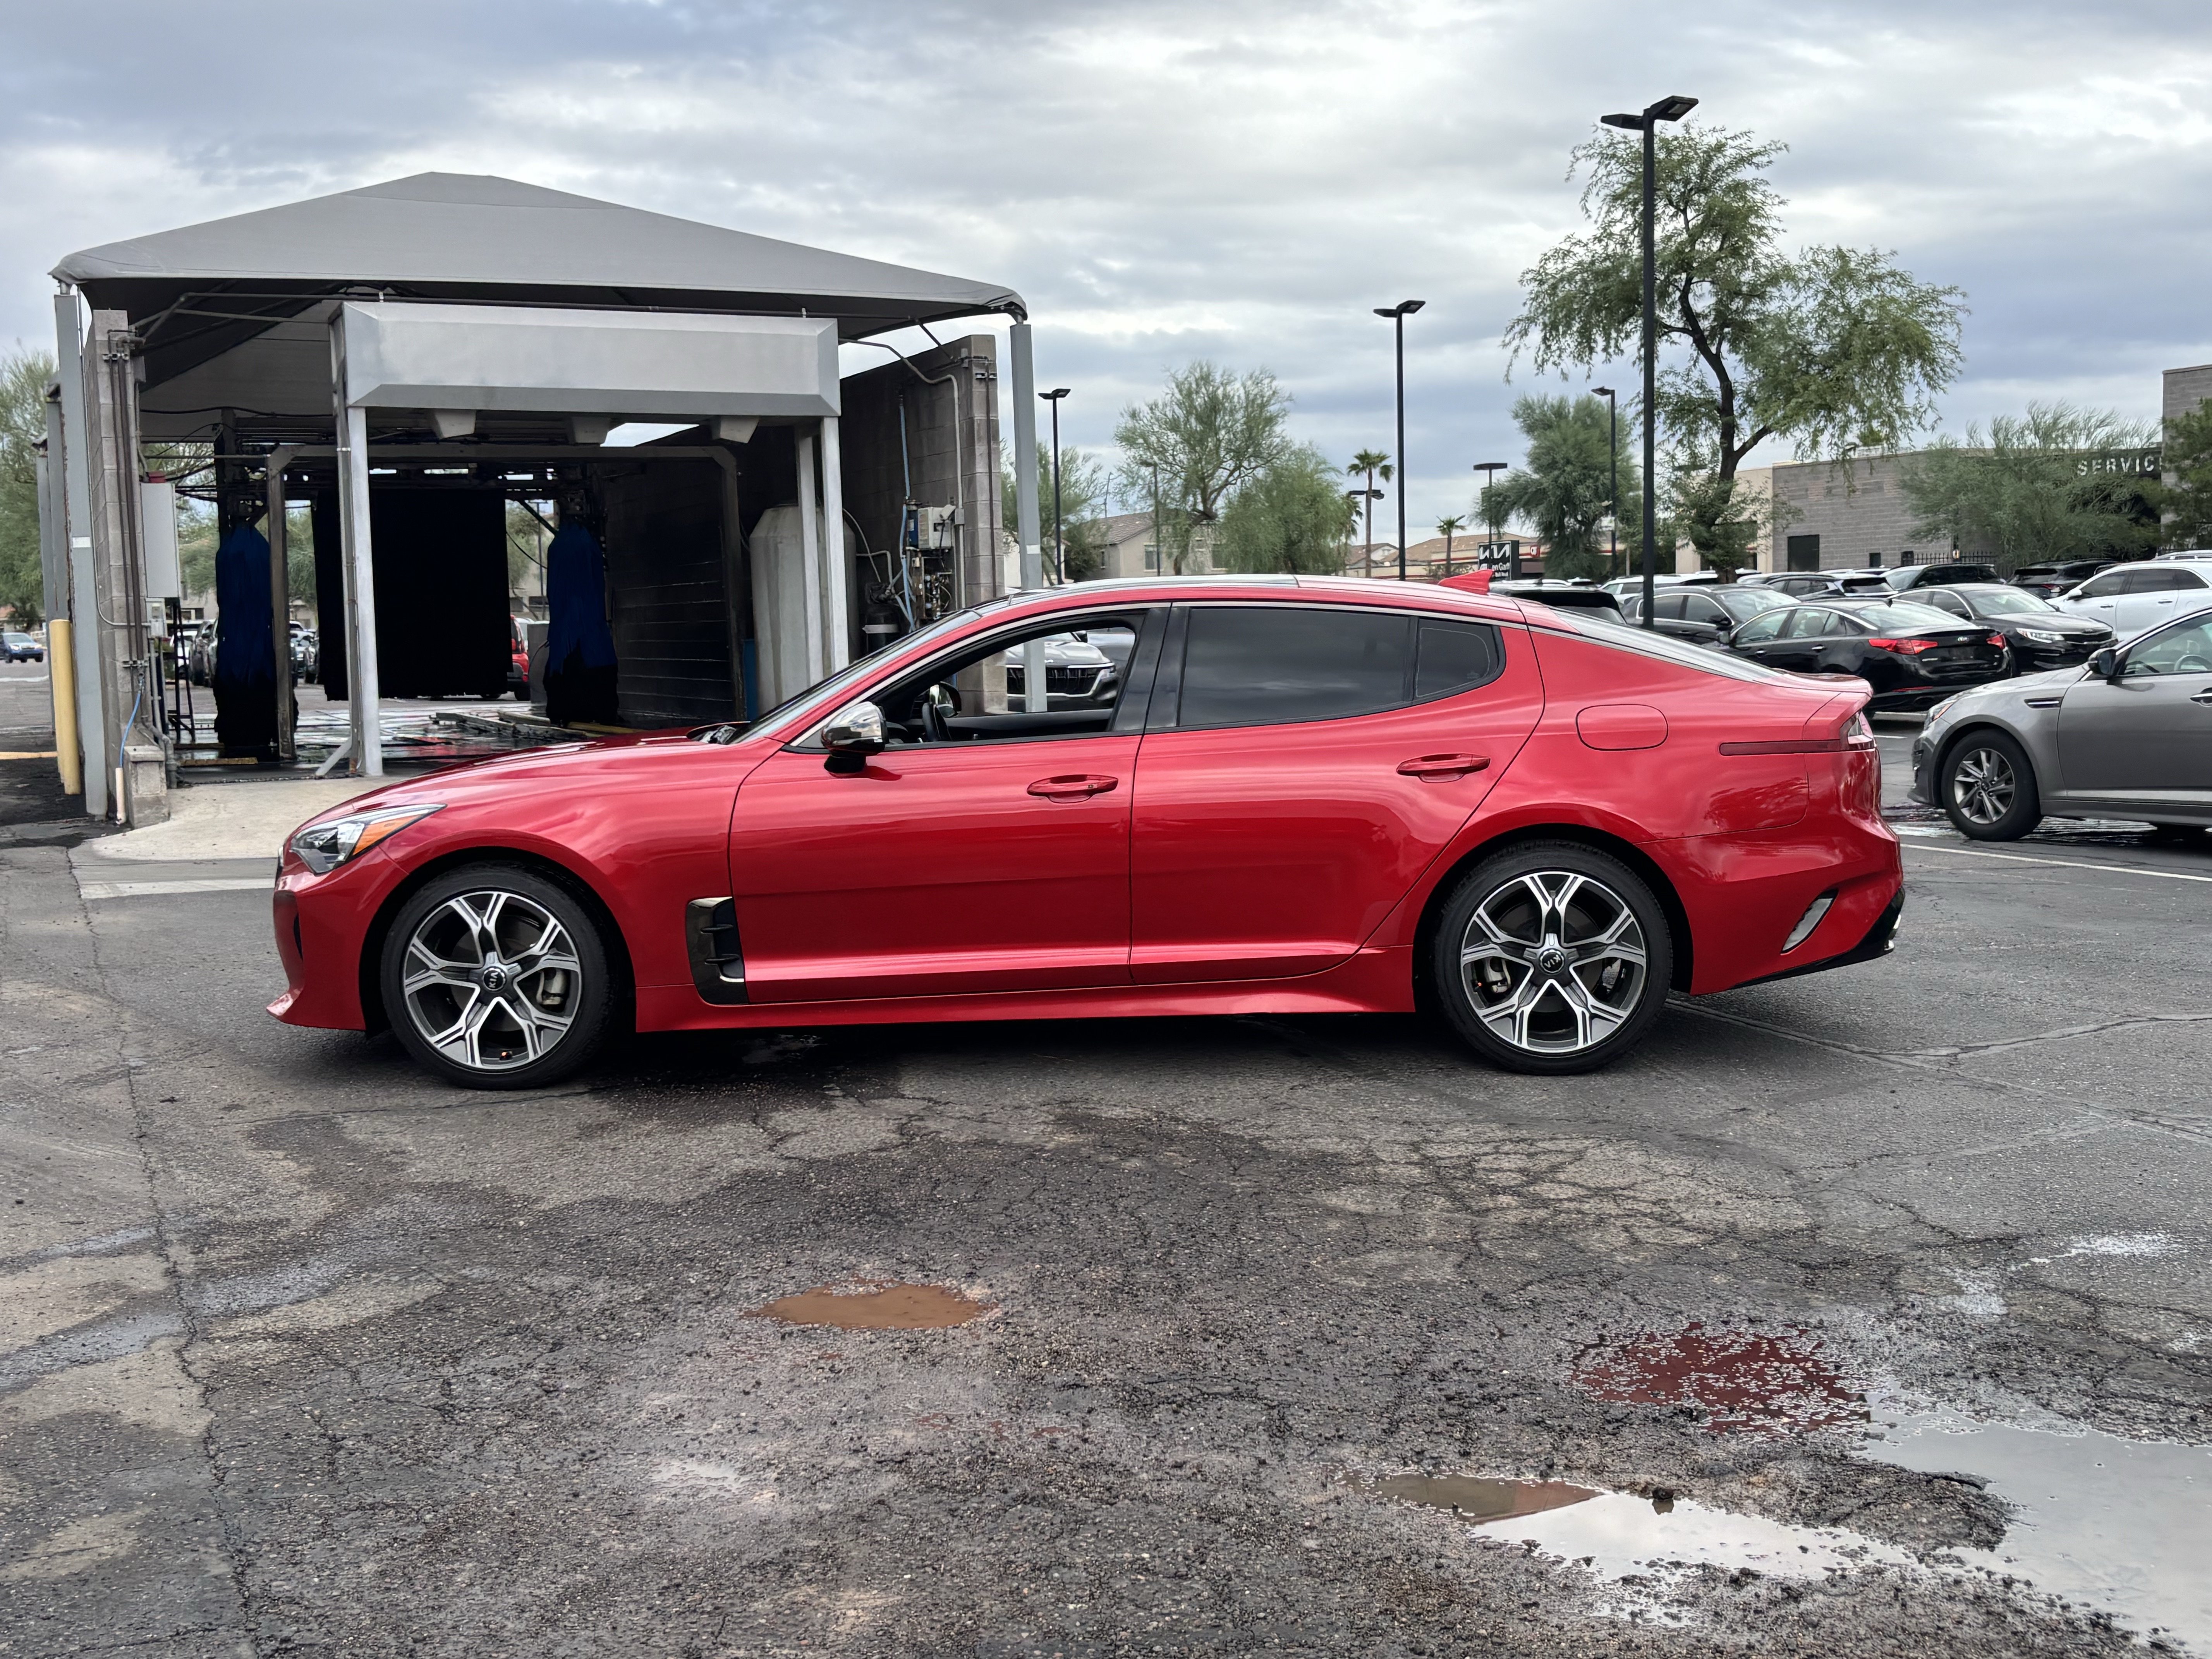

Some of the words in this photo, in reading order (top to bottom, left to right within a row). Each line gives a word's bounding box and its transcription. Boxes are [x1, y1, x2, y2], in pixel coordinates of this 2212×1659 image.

[2077, 456, 2162, 476] SERVIC
[1544, 954, 1561, 968] KIA
[488, 972, 498, 988] KIA
